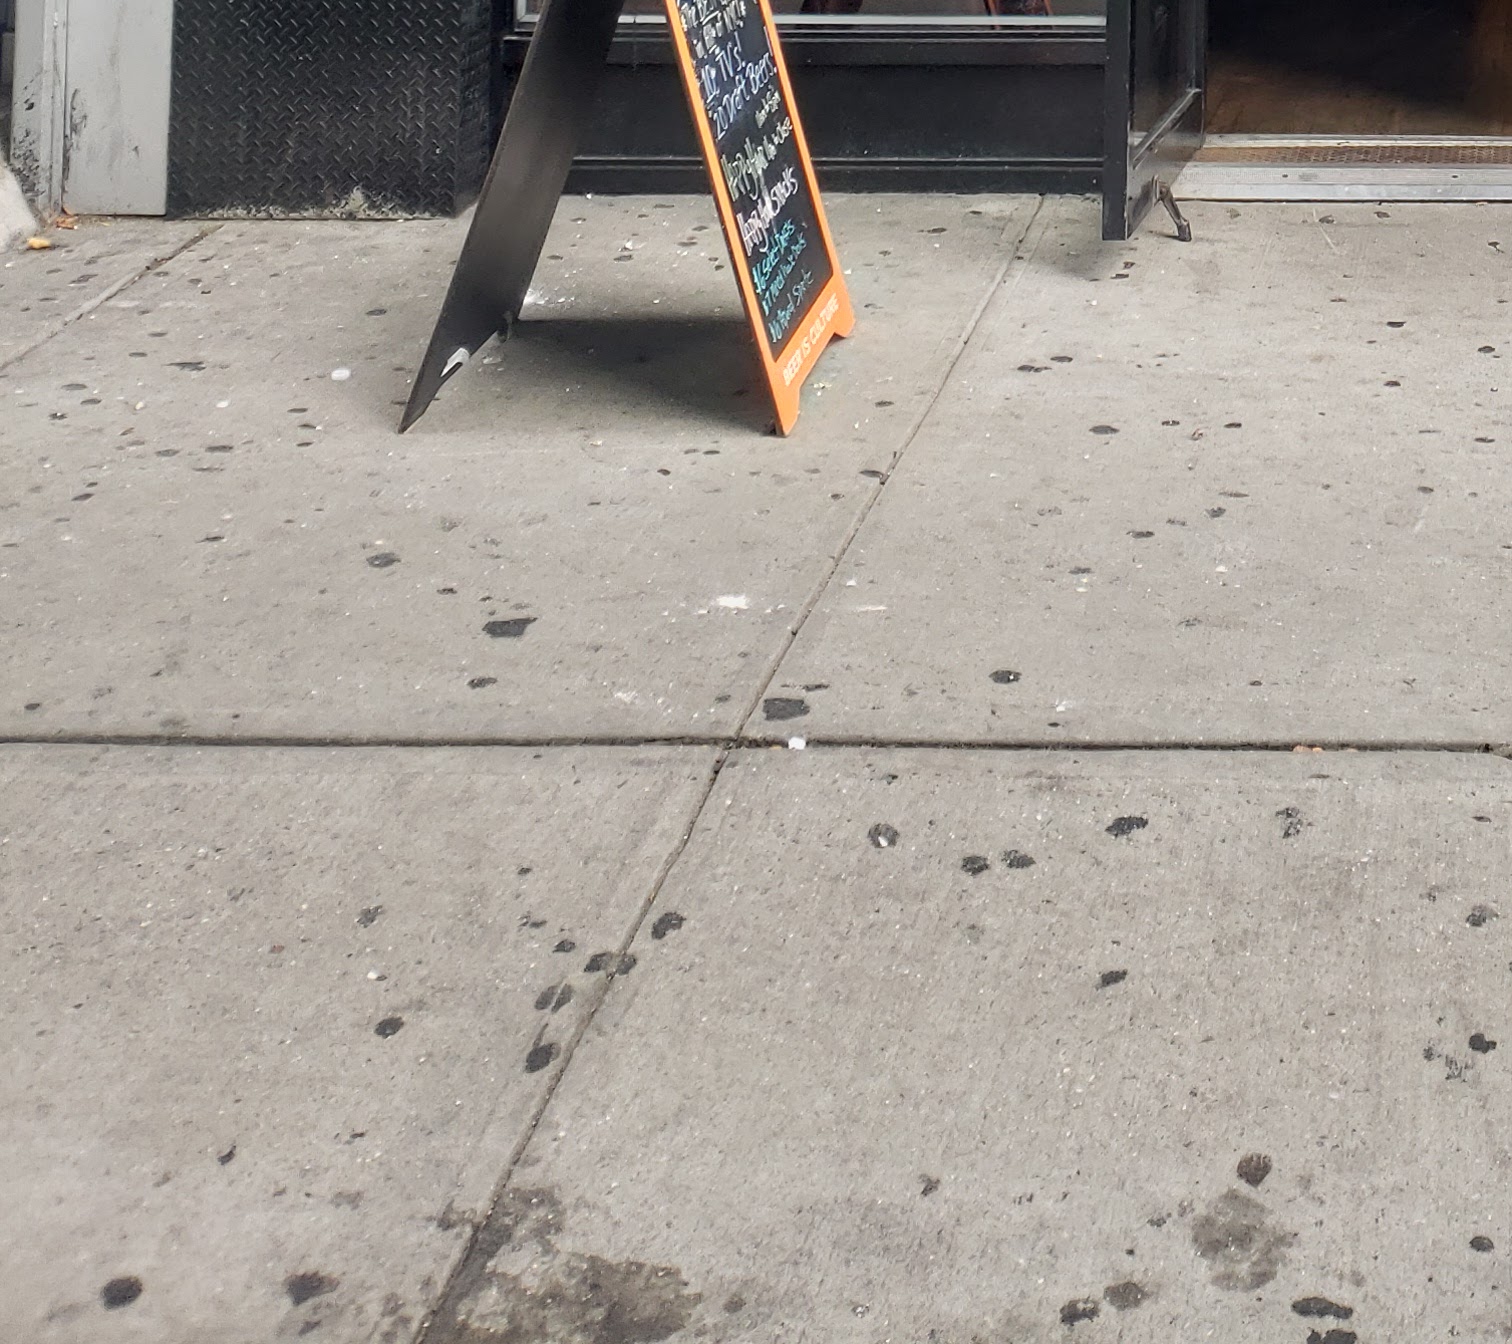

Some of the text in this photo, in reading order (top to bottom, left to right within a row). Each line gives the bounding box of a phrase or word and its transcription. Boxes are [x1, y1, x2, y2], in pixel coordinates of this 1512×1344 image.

[783, 294, 838, 385] BEER IS CULTURE
